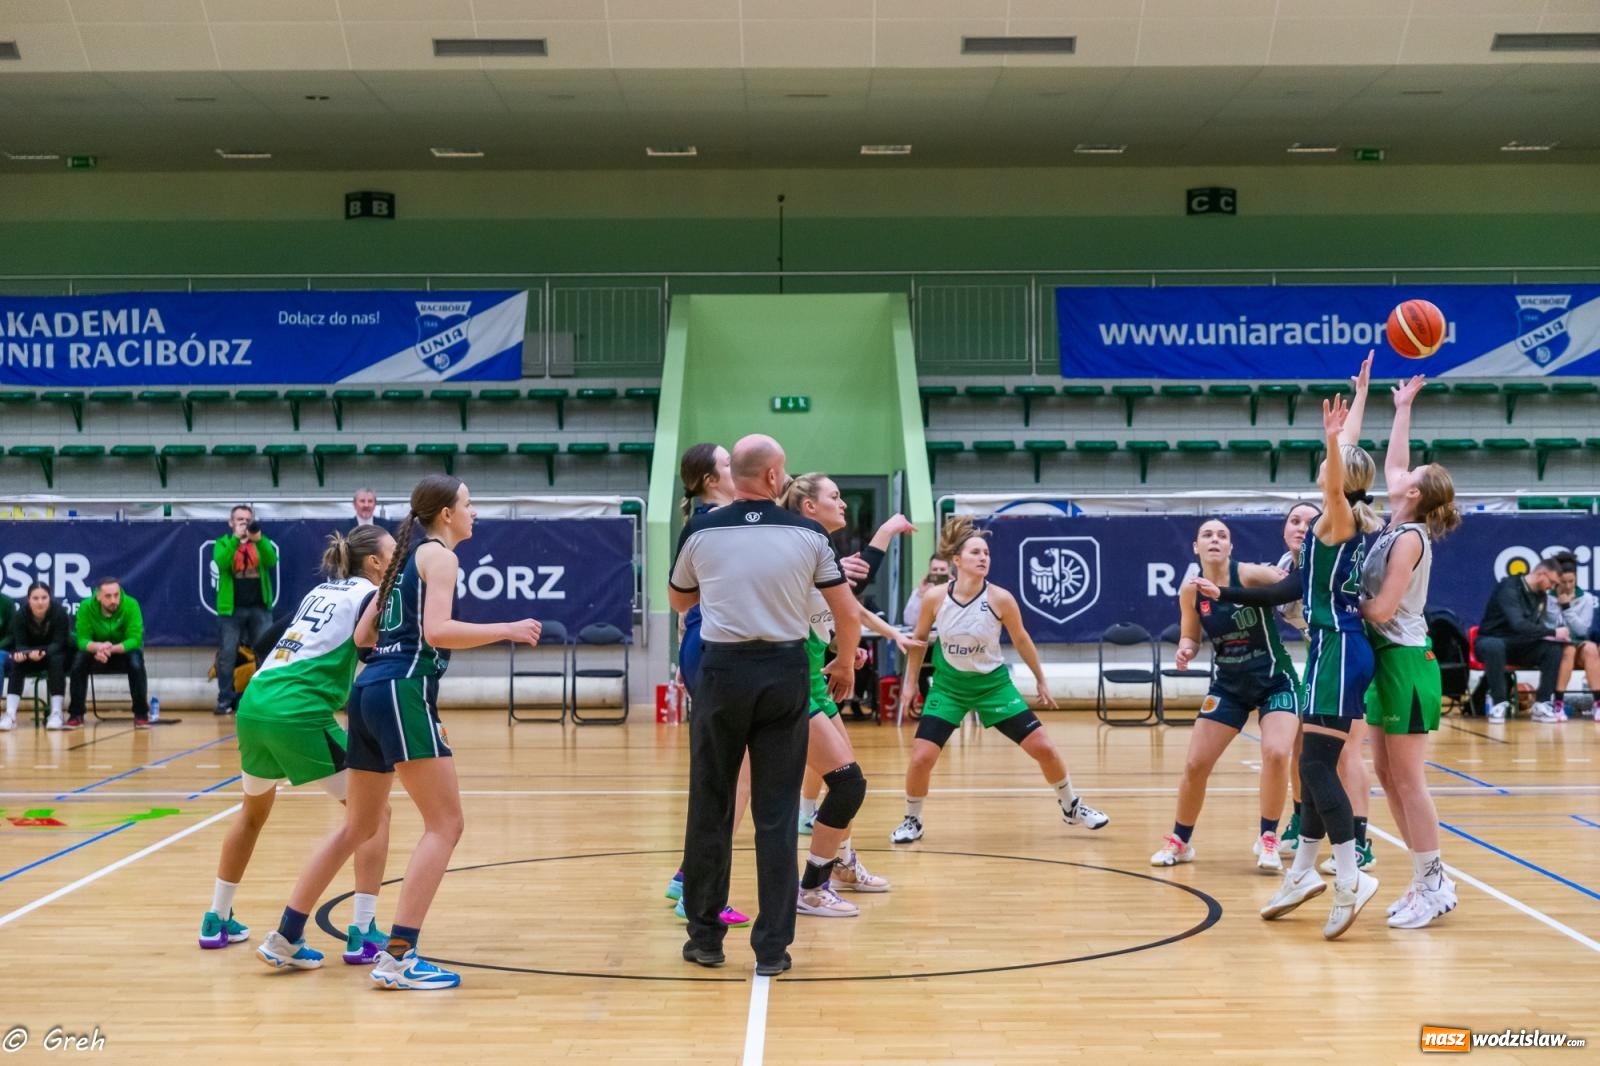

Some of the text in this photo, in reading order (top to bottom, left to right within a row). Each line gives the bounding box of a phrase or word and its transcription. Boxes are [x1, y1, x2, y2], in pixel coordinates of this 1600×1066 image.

[350, 201, 388, 216] B B
[1192, 196, 1233, 212] C C
[329, 311, 347, 325] do
[351, 310, 380, 325] nas!
[420, 328, 463, 355] UNIA
[1521, 320, 1564, 348] UNIA
[69, 333, 253, 369] RACIBÓRZ
[0, 552, 92, 598] SiR
[1231, 606, 1258, 630] 10
